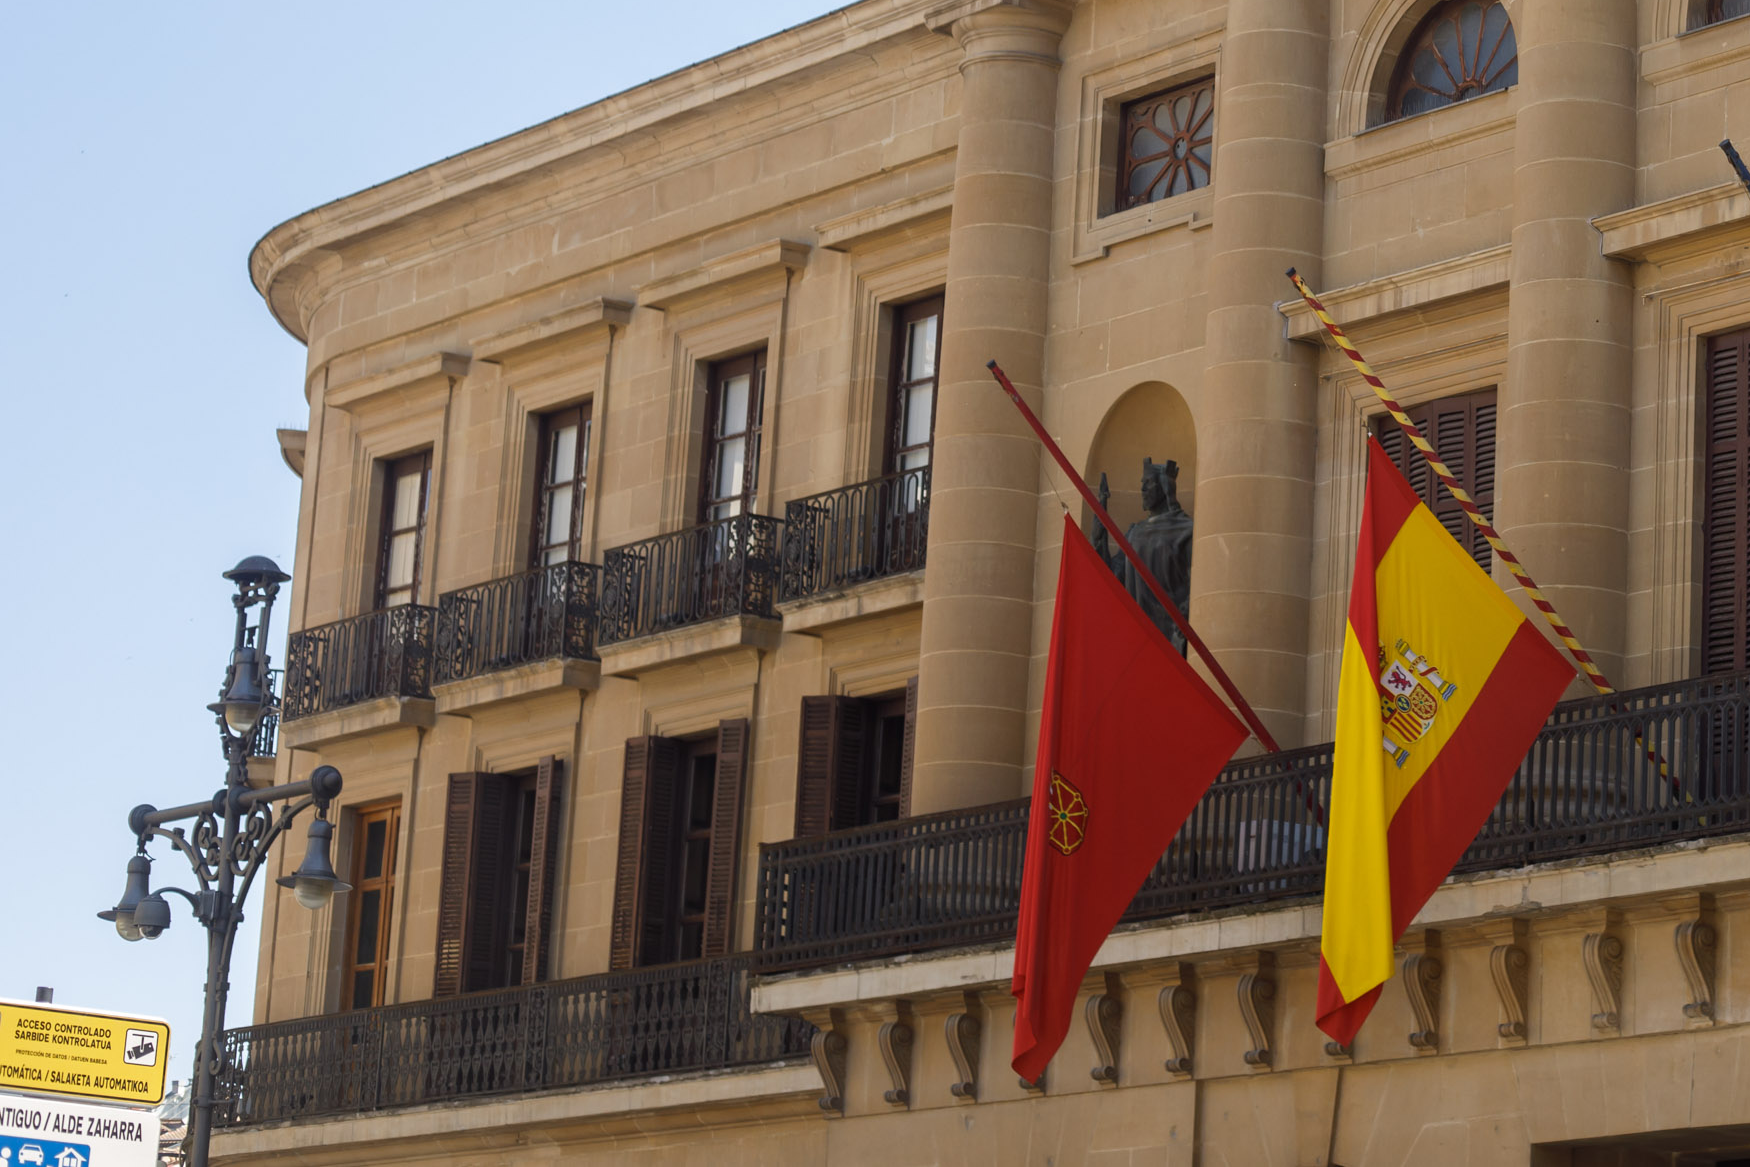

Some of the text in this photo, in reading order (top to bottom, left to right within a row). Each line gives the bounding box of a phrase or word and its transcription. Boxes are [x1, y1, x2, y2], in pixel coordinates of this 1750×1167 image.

[17, 1018, 111, 1038] ACCESO CONTROLADO
[14, 1030, 112, 1050] SARBIDE KONTROLATUA
[15, 1049, 44, 1057] PROTECCIÓN
[71, 1055, 89, 1063] DATUEN
[0, 1063, 42, 1081] TOMÁTICA
[50, 1070, 91, 1086] SALAKETA
[93, 1075, 149, 1094] AUTOMATIKOA
[52, 1113, 84, 1136] ALDE
[86, 1117, 143, 1142] ZAHARRA
